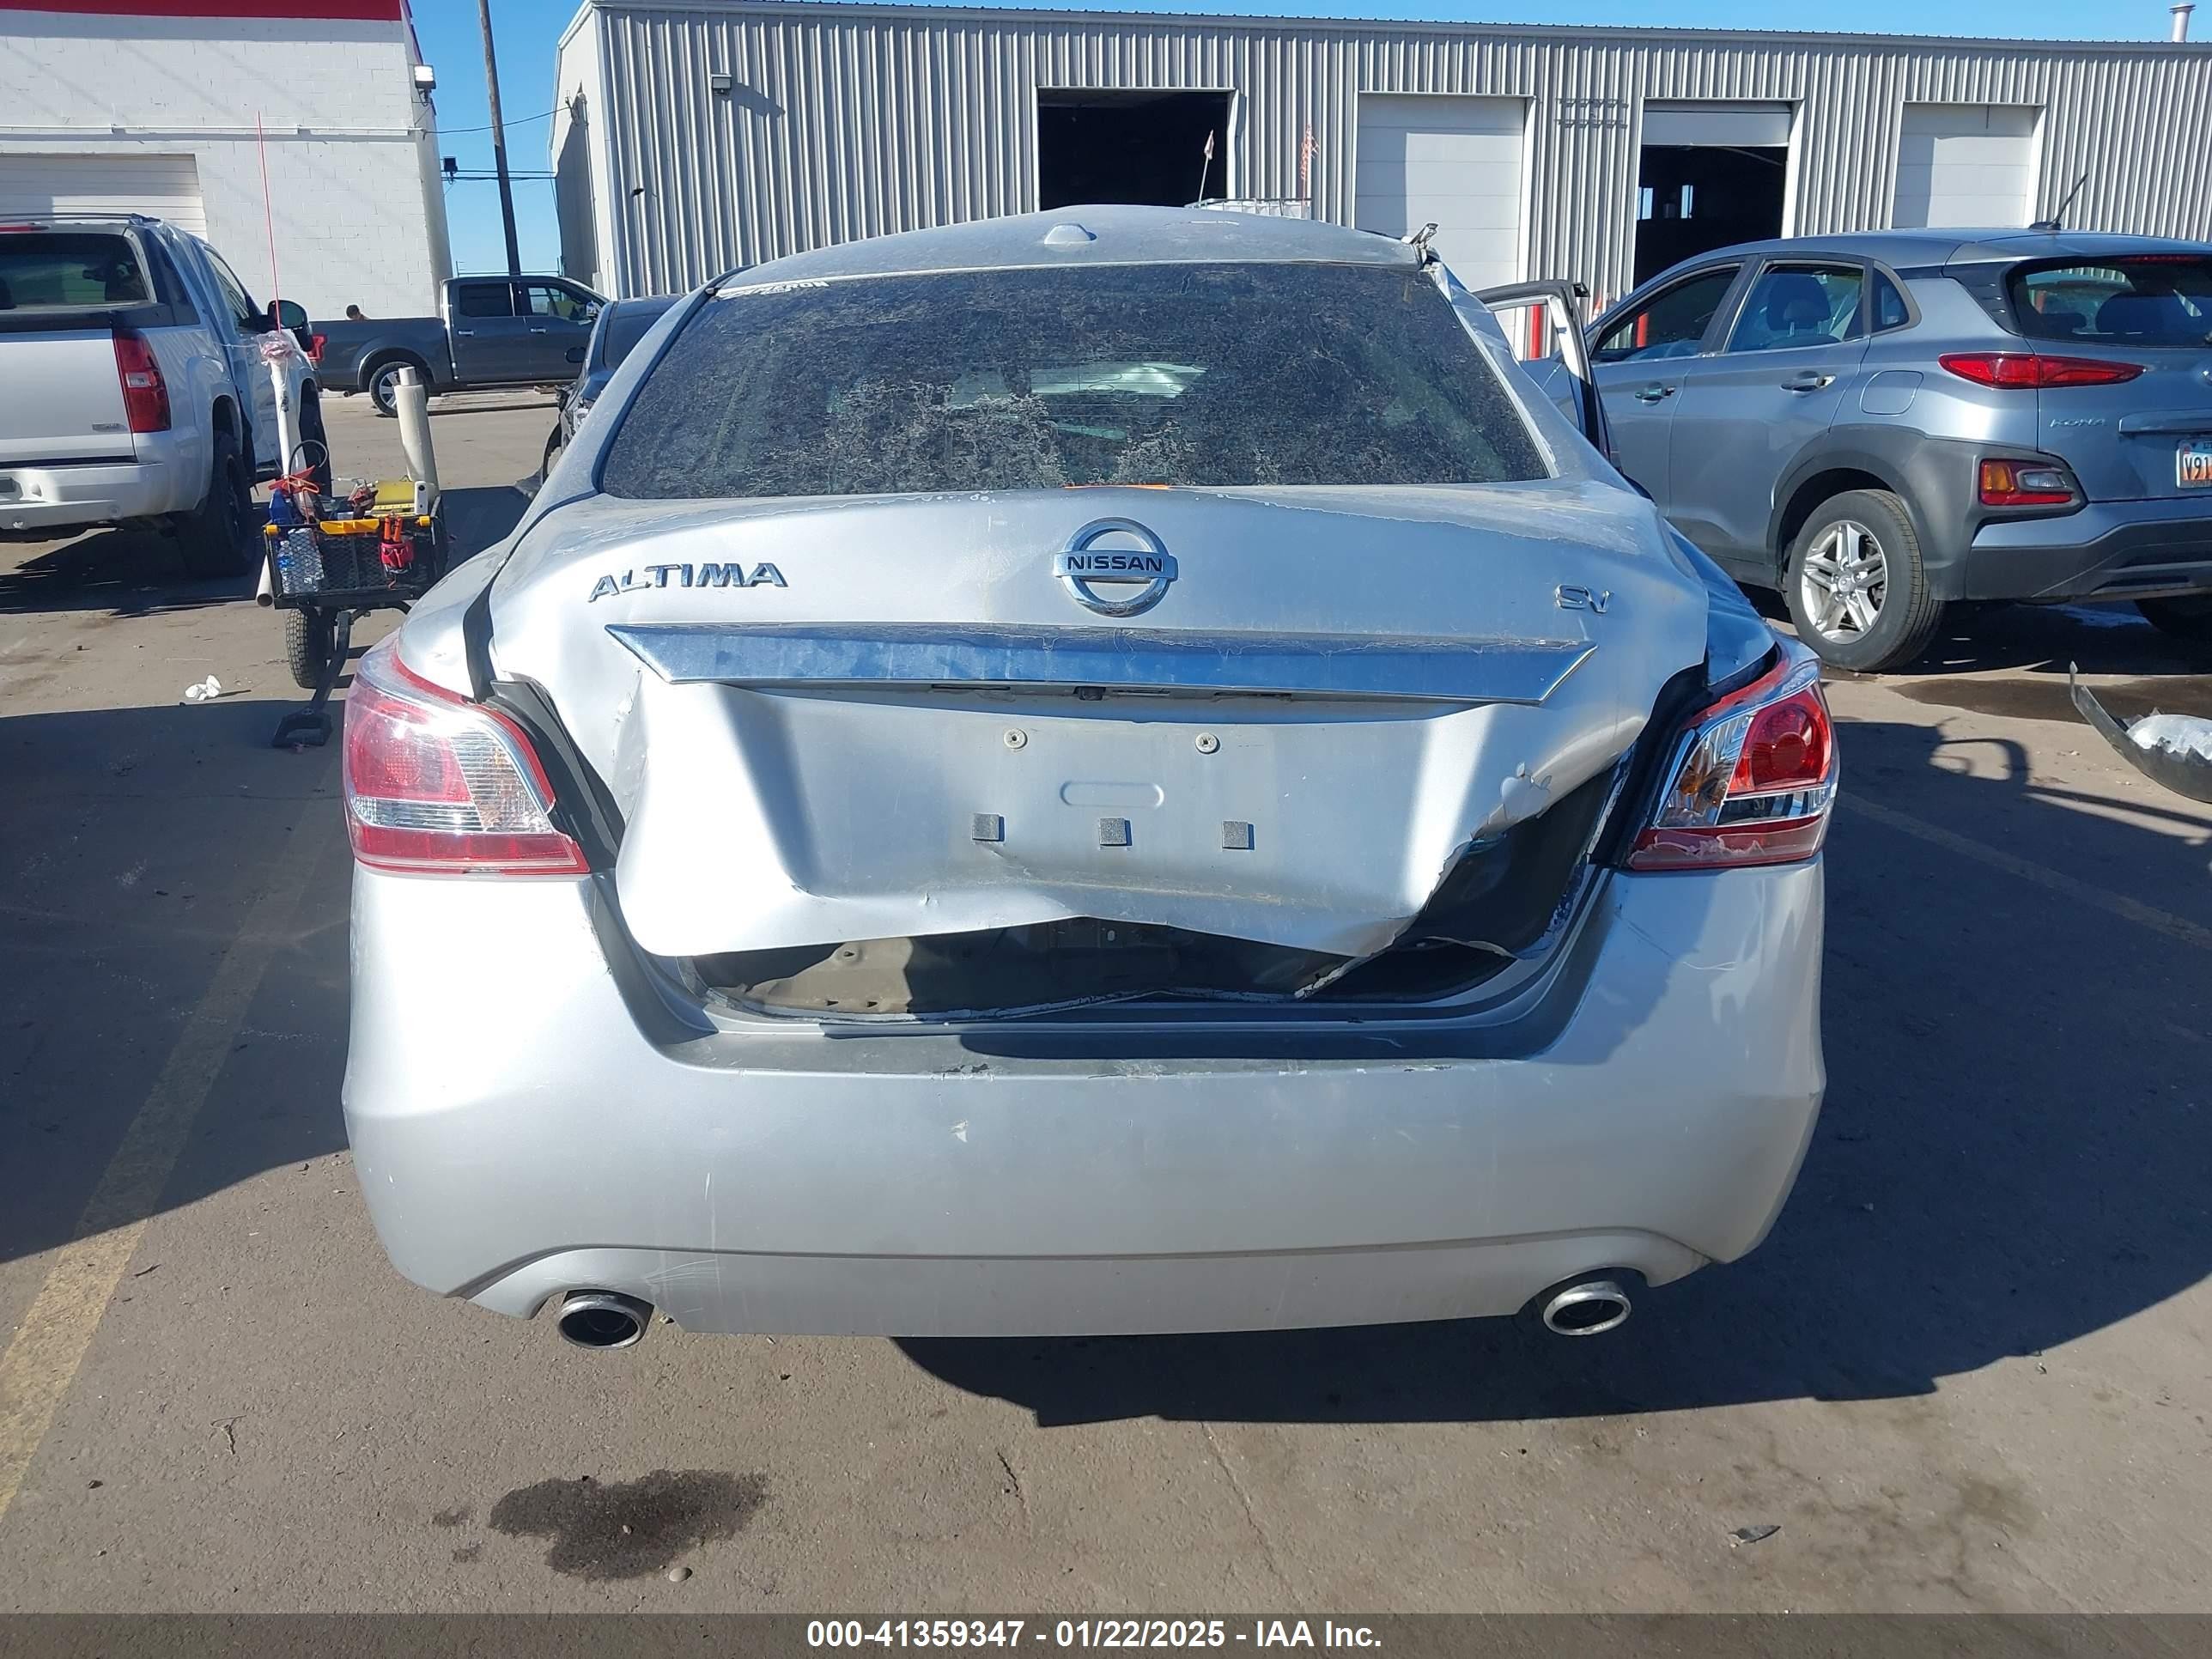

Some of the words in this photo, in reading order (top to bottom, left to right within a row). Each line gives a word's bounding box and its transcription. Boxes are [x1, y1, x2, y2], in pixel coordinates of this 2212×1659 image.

[2184, 456, 2209, 481] V91
[1067, 556, 1164, 573] NISSAN
[587, 562, 790, 603] ALTIMA
[1554, 584, 1610, 614] SV
